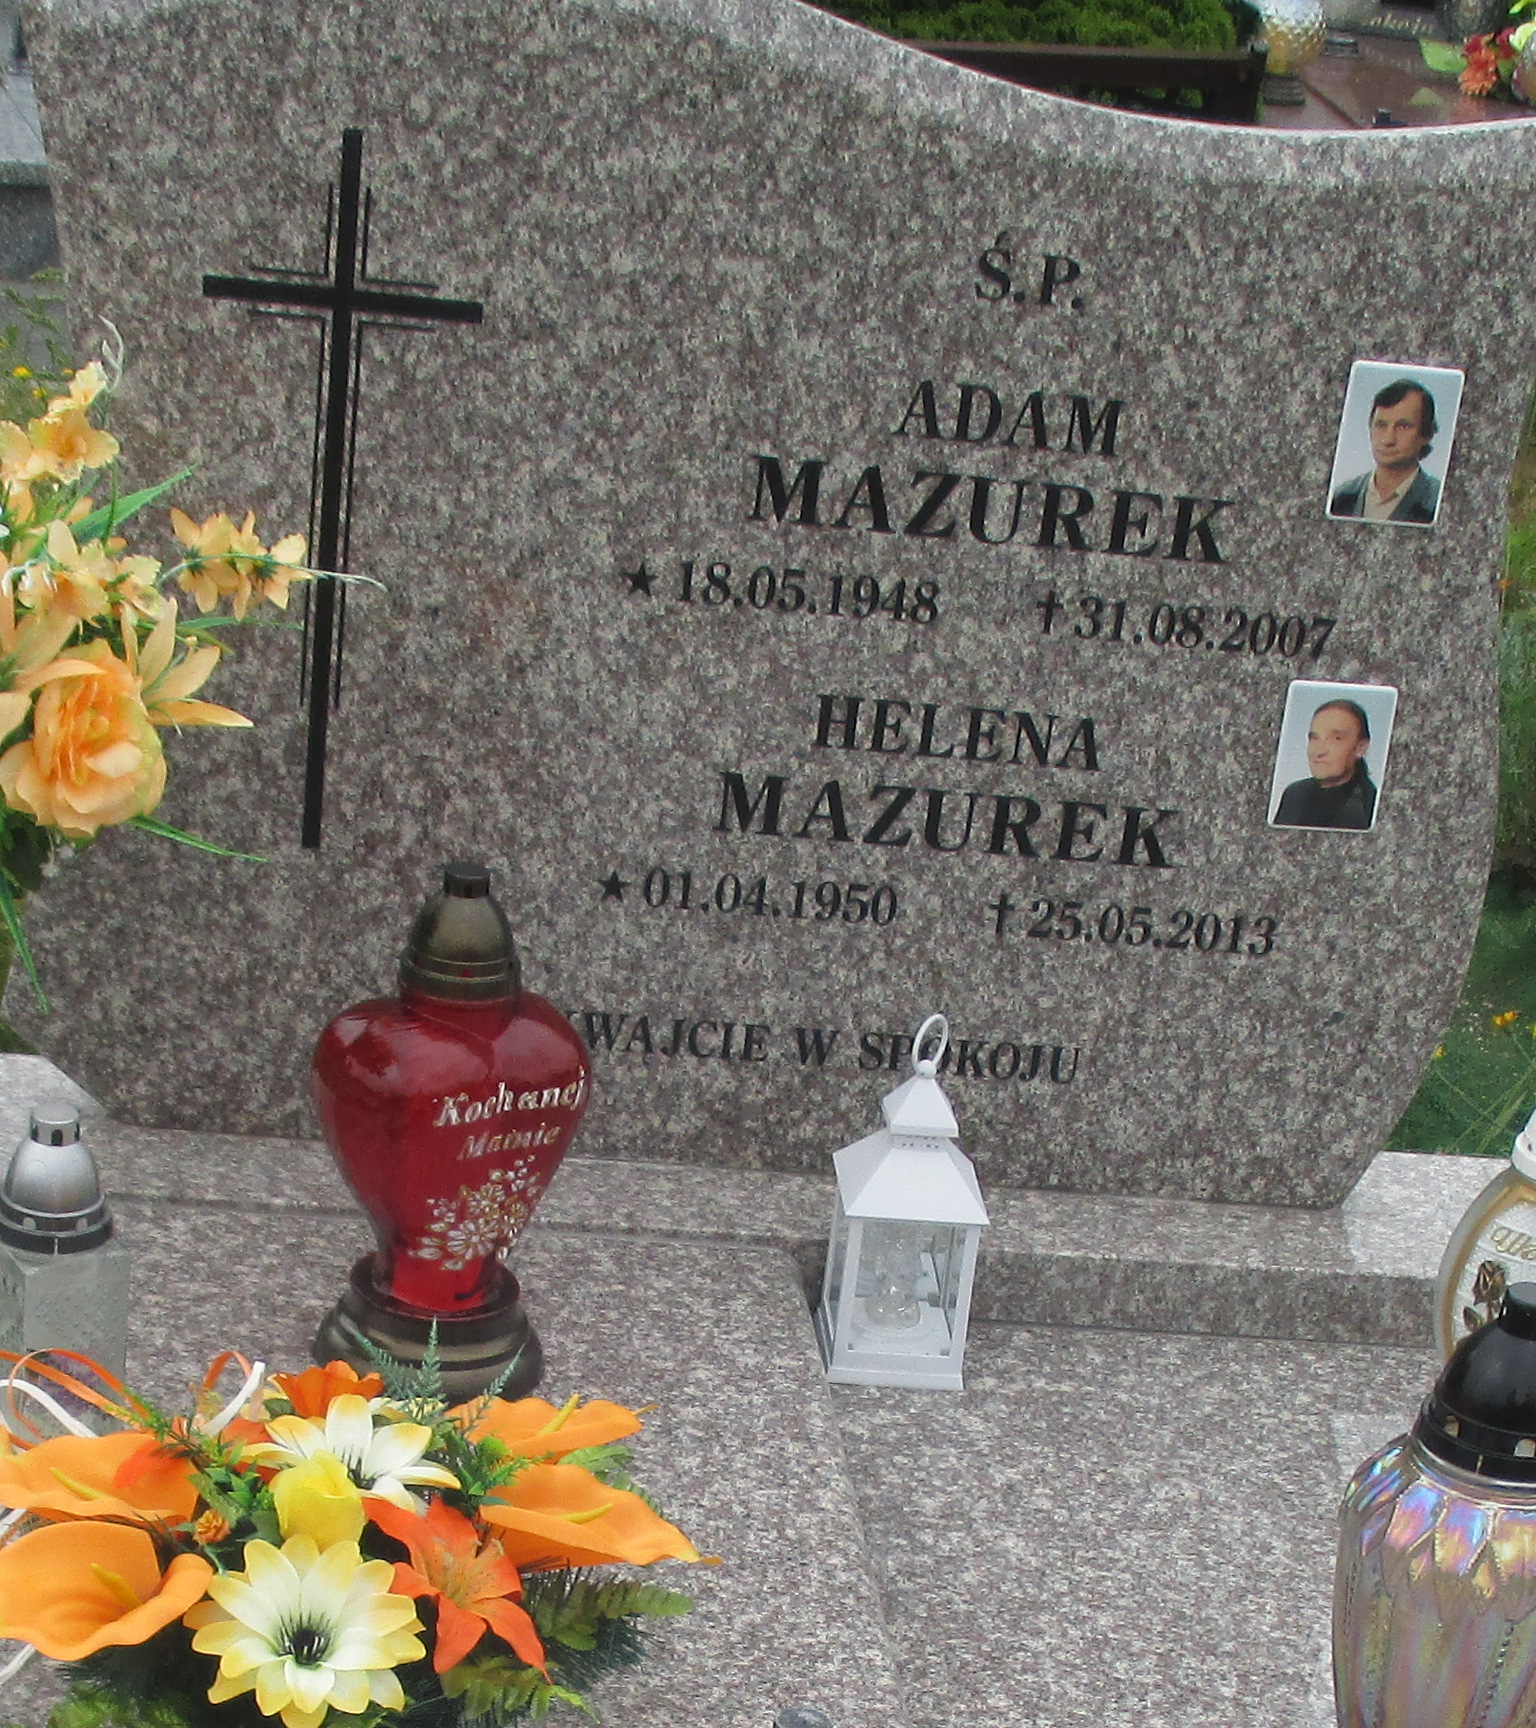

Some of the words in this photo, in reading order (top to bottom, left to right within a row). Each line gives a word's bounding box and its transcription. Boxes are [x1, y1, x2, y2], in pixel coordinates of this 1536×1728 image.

[974, 230, 1084, 306] Ś.P.
[891, 379, 1125, 455] ADAM
[747, 455, 1235, 564] MAZUREK
[678, 561, 940, 624] 18.05.1948
[815, 694, 1099, 771] HELENA
[713, 770, 1181, 869] MAZUREK
[642, 866, 898, 926] 01.04.1950
[567, 1011, 771, 1062] WAJCIE
[795, 1026, 840, 1067] W
